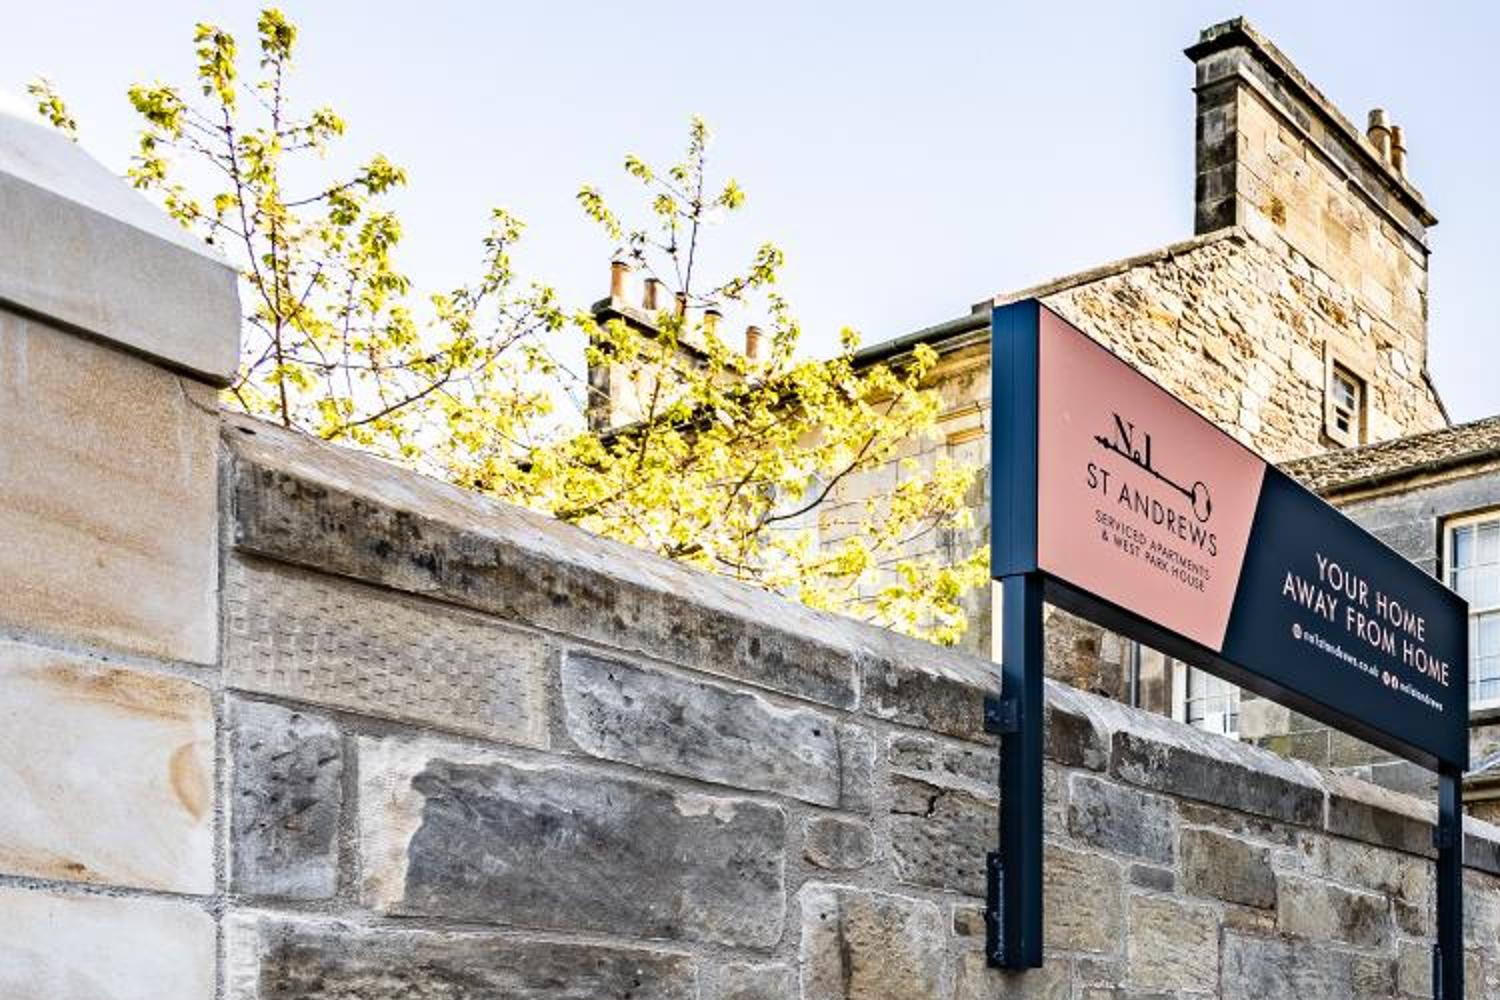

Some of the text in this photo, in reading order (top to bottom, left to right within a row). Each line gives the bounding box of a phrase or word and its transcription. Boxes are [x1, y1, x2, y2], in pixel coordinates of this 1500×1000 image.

[1087, 463, 1218, 557] ST ANDREWS
[1095, 509, 1211, 581] SERVICED APARTMENTS
[1101, 530, 1206, 593] & WEST PARK HOUSE
[1316, 552, 1426, 643] YOUR HOME
[1283, 571, 1450, 688] AWAY FROM HOME
